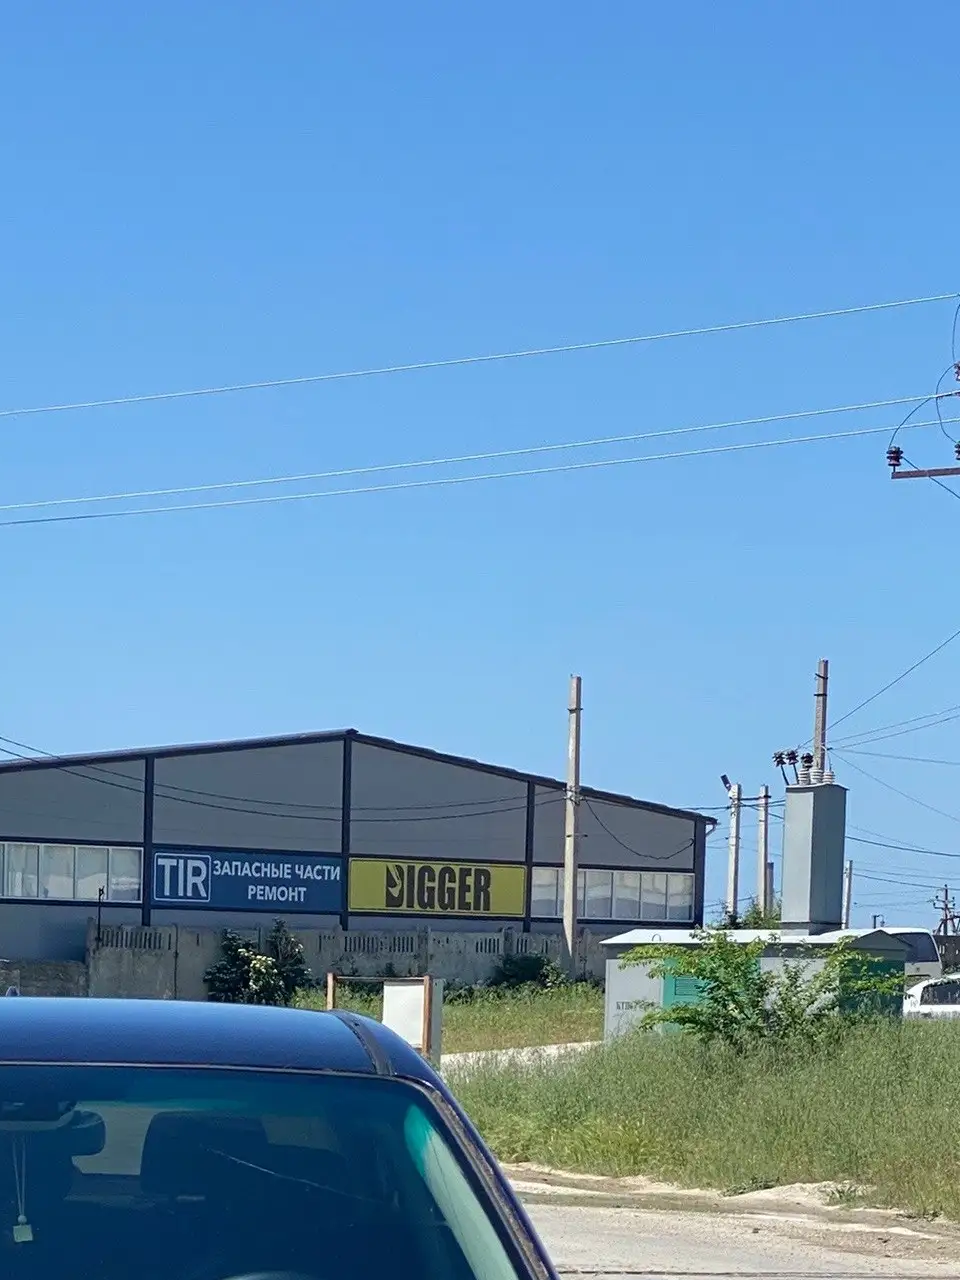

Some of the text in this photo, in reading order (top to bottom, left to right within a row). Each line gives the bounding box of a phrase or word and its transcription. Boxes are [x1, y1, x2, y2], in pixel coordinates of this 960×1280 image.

[157, 858, 208, 898] TIR
[213, 860, 340, 881] ЗАПАСНЫЕ ЧАСТИ
[247, 885, 307, 902] РЕМОНТ
[385, 863, 491, 911] DIGGER
